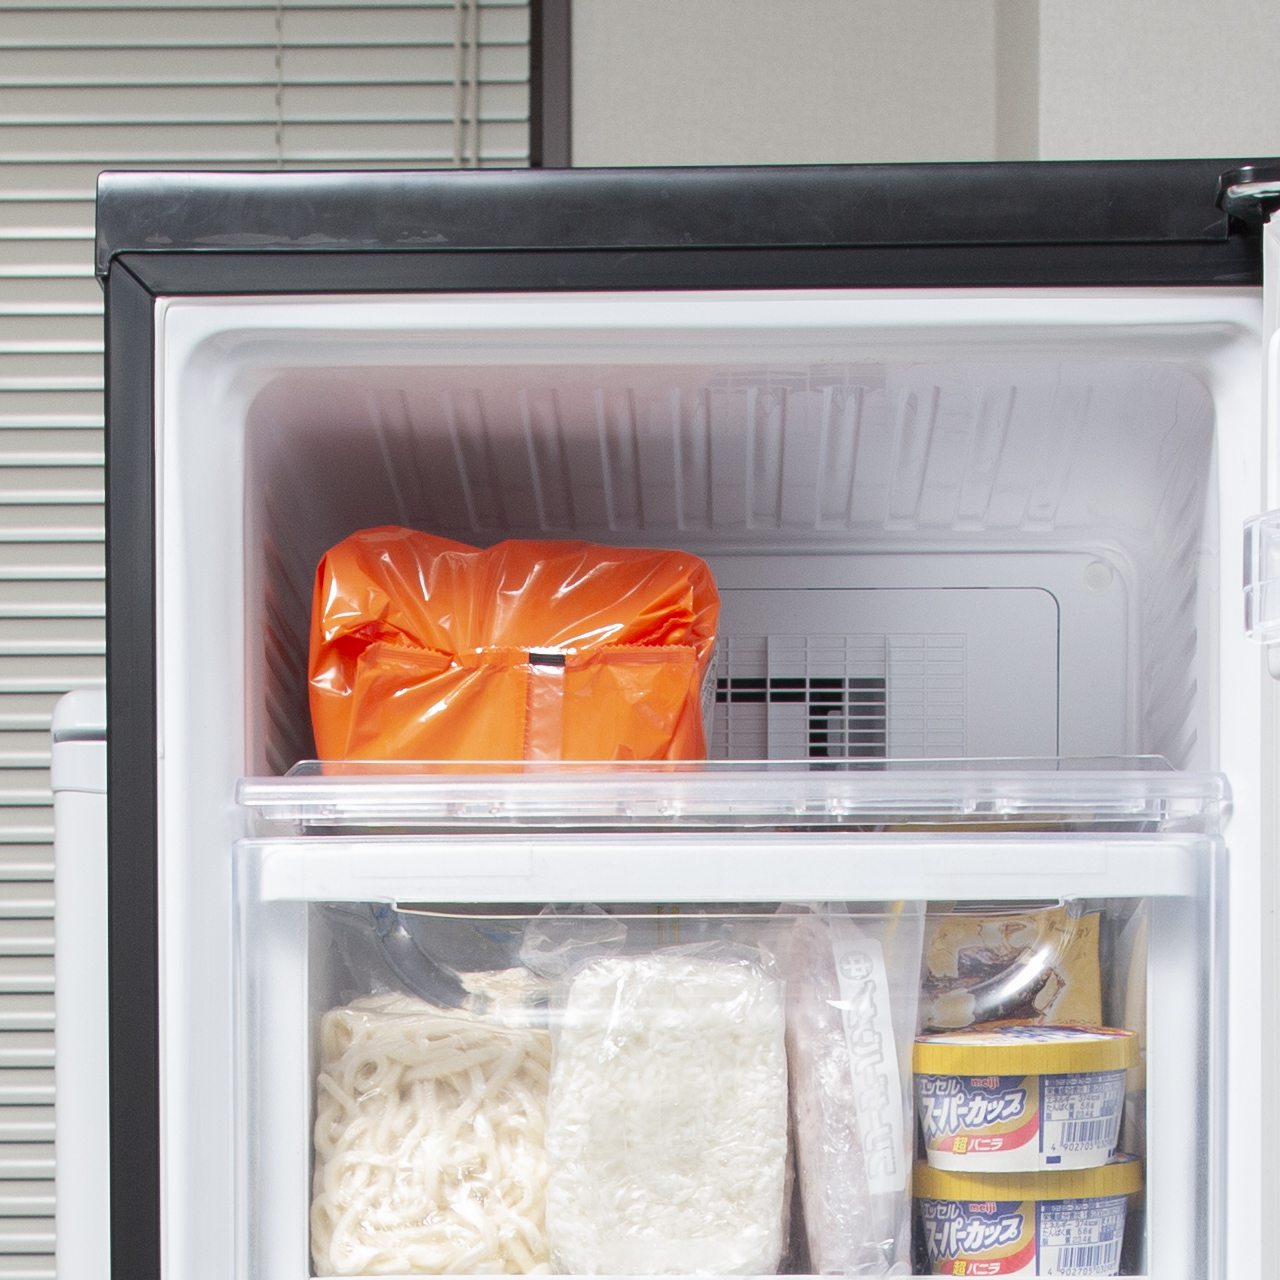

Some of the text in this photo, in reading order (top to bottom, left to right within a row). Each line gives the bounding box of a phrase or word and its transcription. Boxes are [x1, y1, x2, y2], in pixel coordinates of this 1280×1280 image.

[920, 1078, 960, 1095] エッセル
[971, 1076, 999, 1089] meiji
[922, 1092, 1024, 1135] スーパーカップ
[952, 1136, 1004, 1154] 超バニラ
[924, 1203, 959, 1219] エッセル
[969, 1201, 997, 1215] meiji
[926, 1217, 1021, 1260] スーパーカップ
[952, 1260, 1001, 1276] 超バニラ
